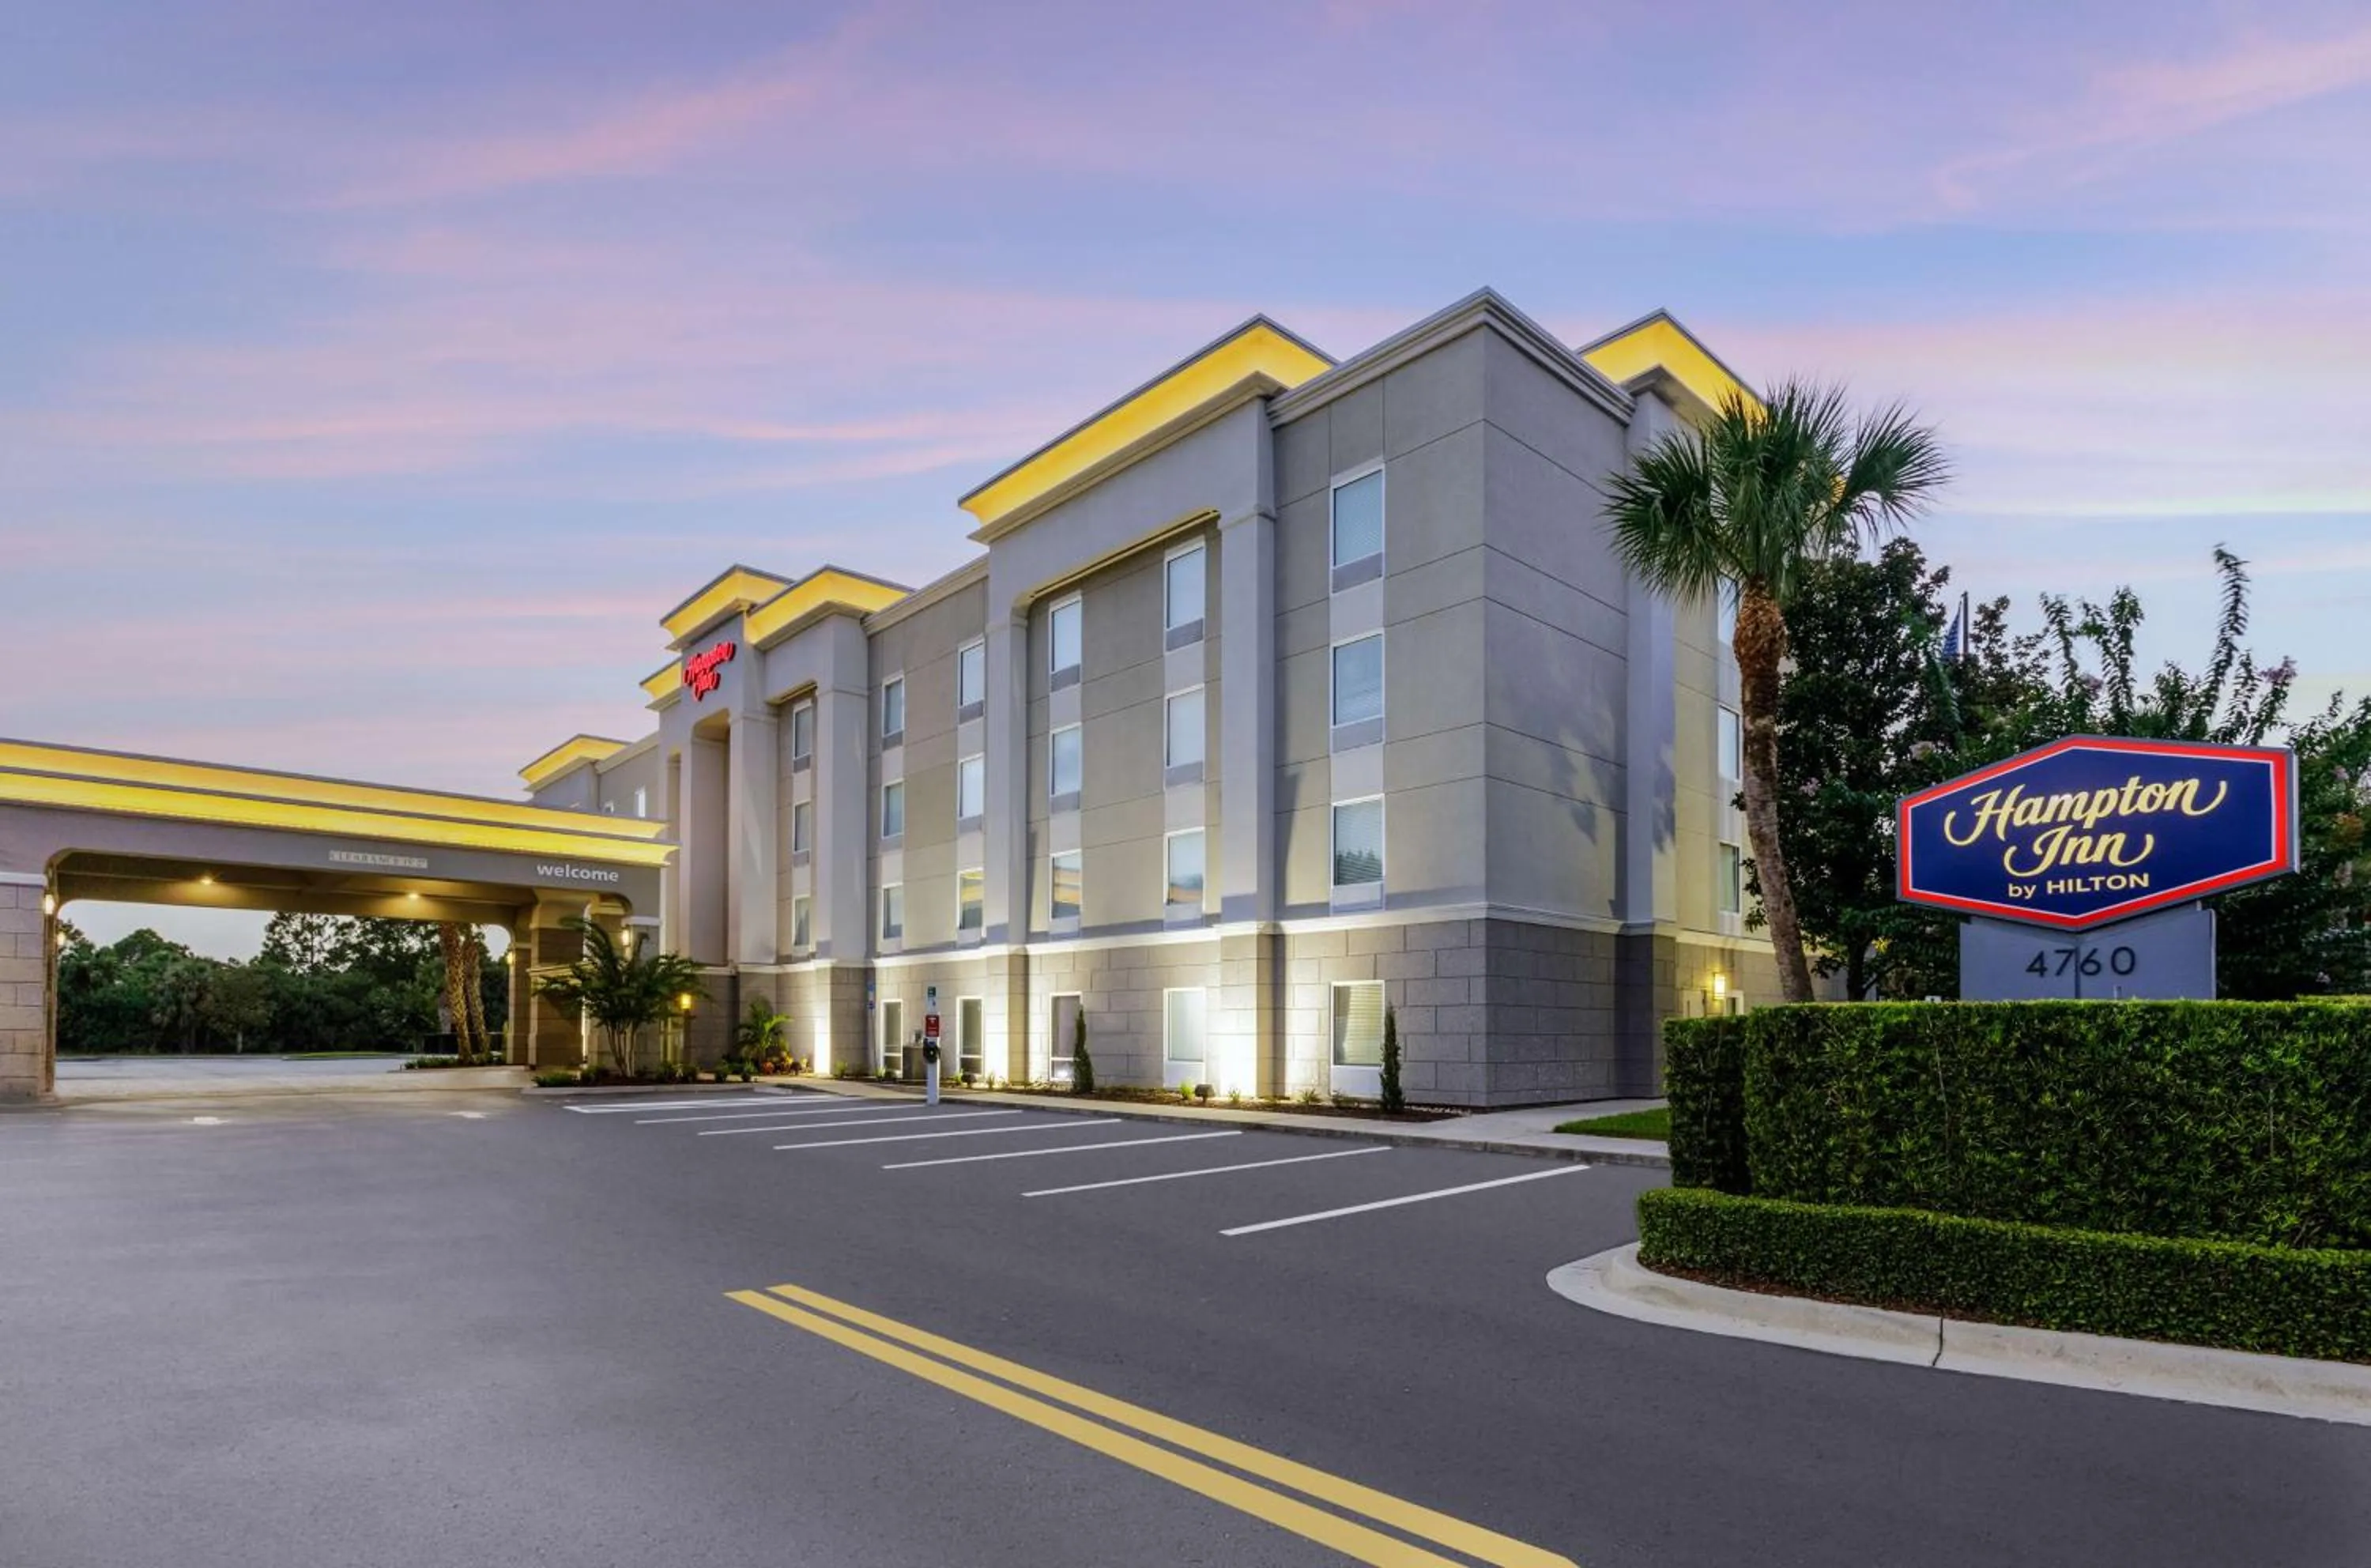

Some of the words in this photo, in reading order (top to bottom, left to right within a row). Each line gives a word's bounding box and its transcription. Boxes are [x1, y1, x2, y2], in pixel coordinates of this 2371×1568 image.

[1944, 775, 2228, 846] Hampton
[2003, 825, 2154, 877] Inn
[537, 864, 619, 882] welcome
[2008, 883, 2037, 899] by
[2046, 873, 2150, 895] HILTON
[2025, 946, 2136, 978] 4760
